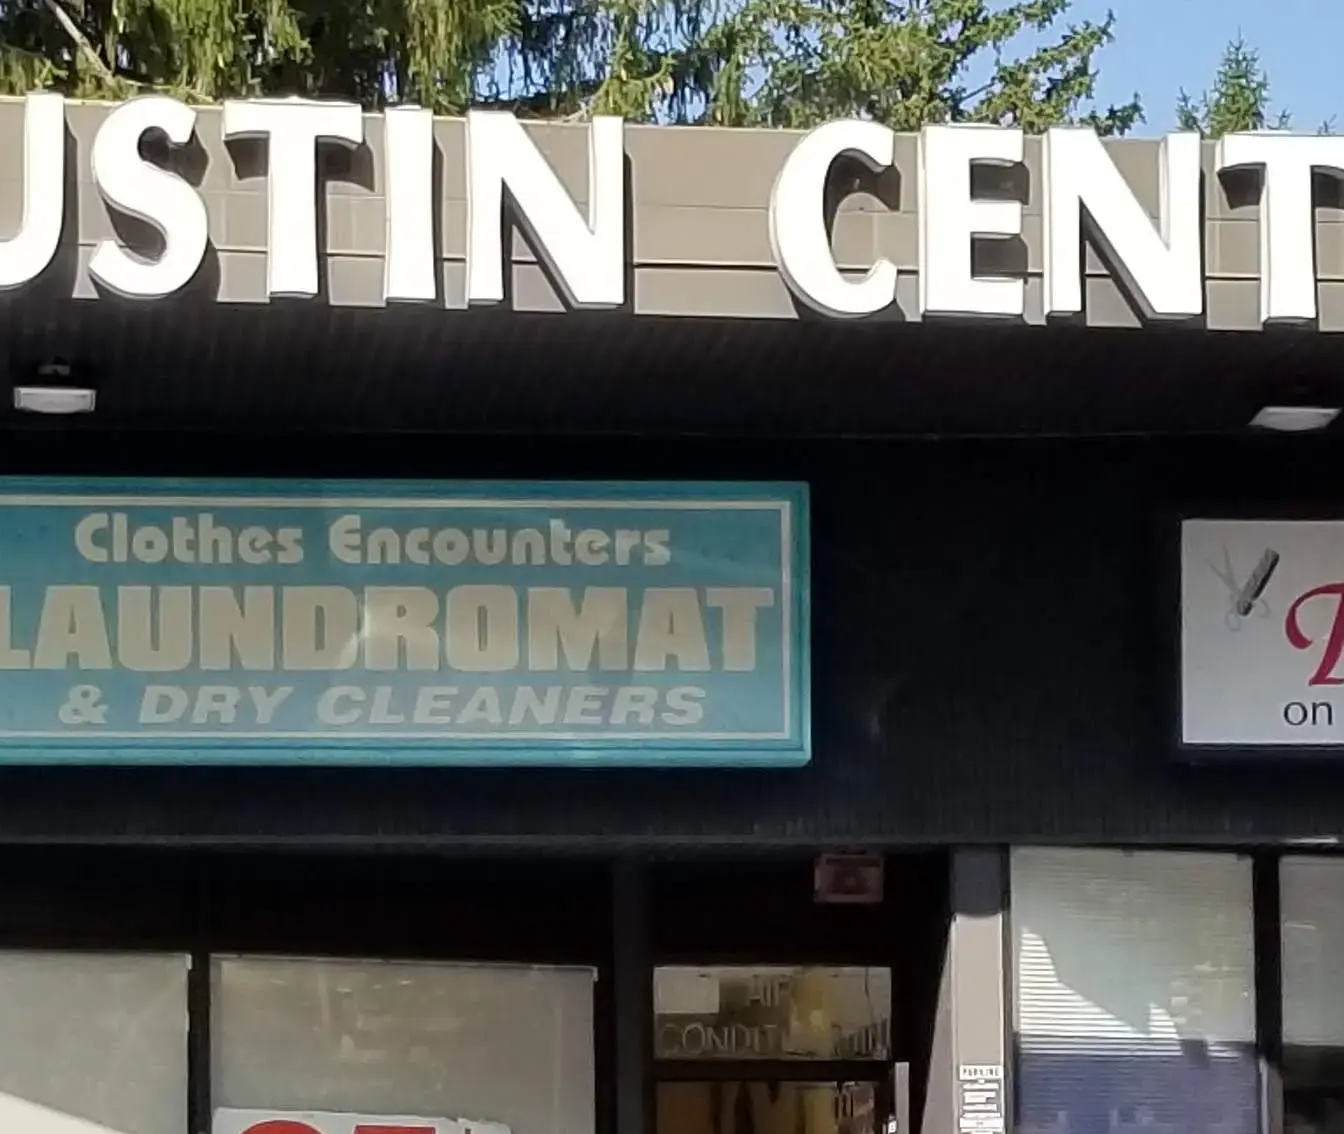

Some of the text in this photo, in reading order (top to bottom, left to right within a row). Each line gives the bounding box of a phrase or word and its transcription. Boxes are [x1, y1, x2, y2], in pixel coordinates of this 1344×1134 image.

[74, 512, 672, 567] Clothes Encounters
[58, 684, 707, 727] & DRY CLEANERS
[1283, 699, 1334, 727] on
